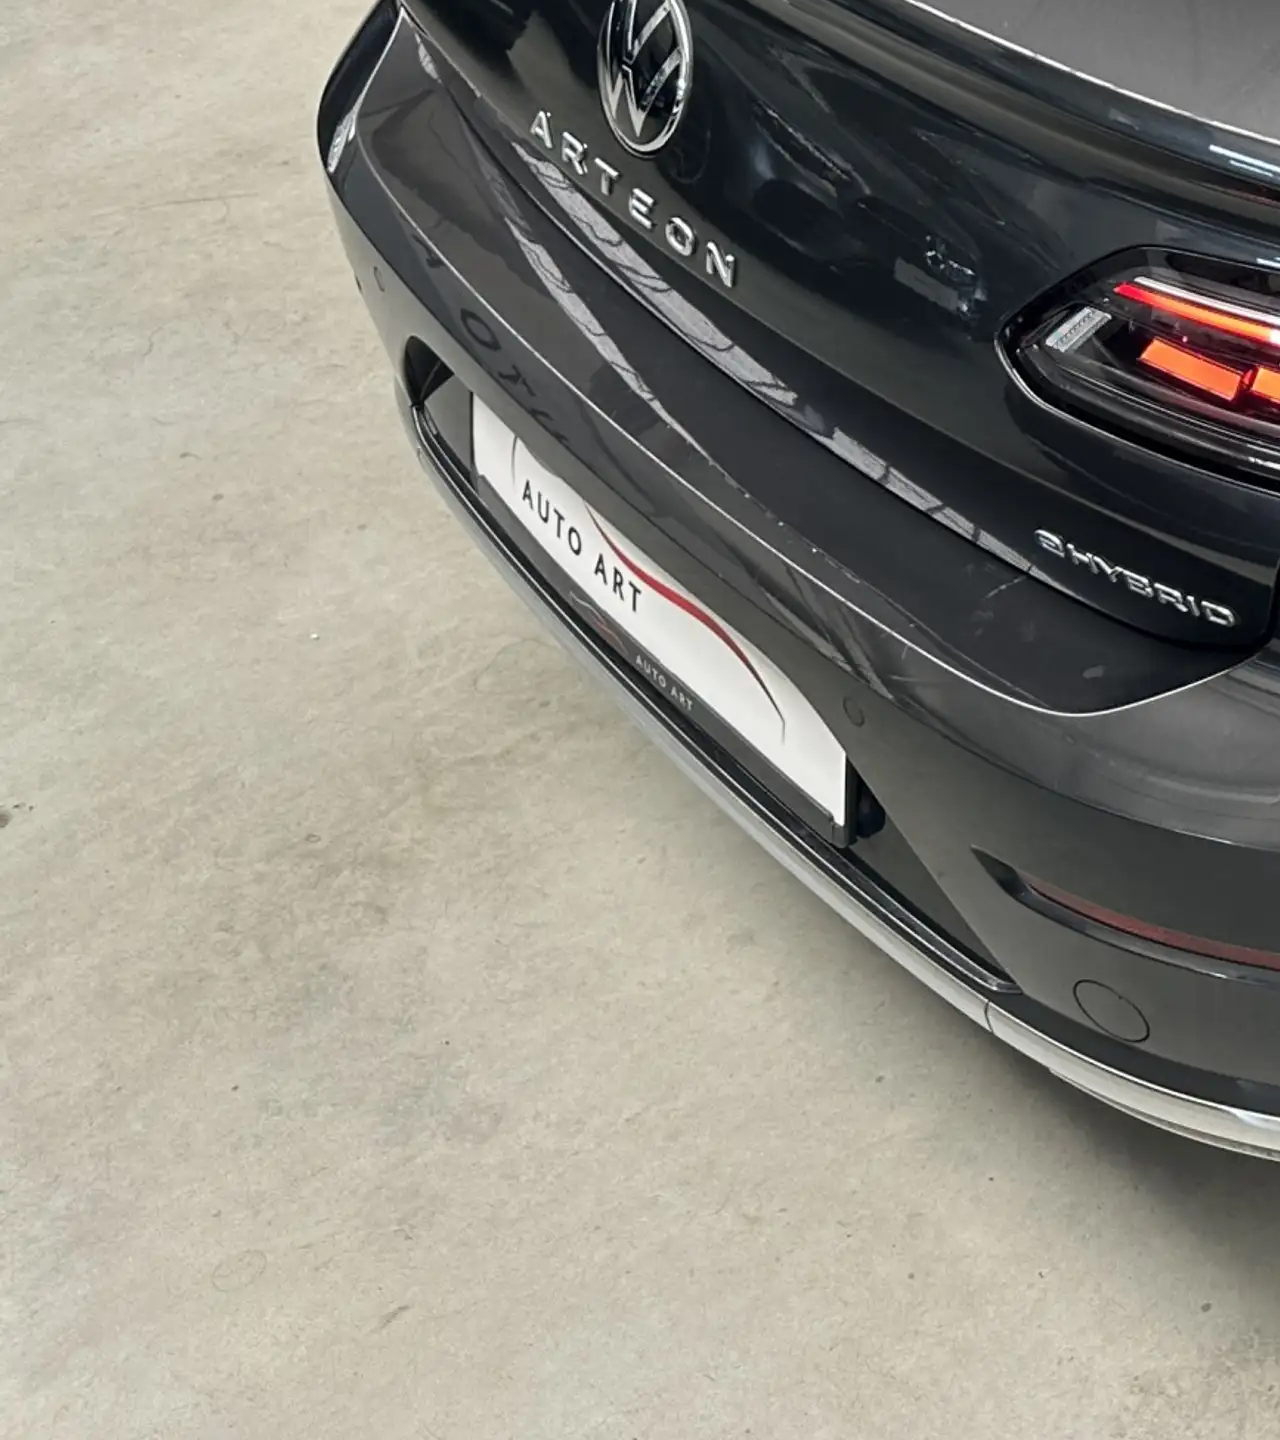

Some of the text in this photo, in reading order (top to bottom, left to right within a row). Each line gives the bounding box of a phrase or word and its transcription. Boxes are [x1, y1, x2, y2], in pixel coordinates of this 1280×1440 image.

[530, 110, 735, 288] ARTEON
[521, 479, 643, 613] AUTO ART
[635, 654, 694, 712] AUTO ART
